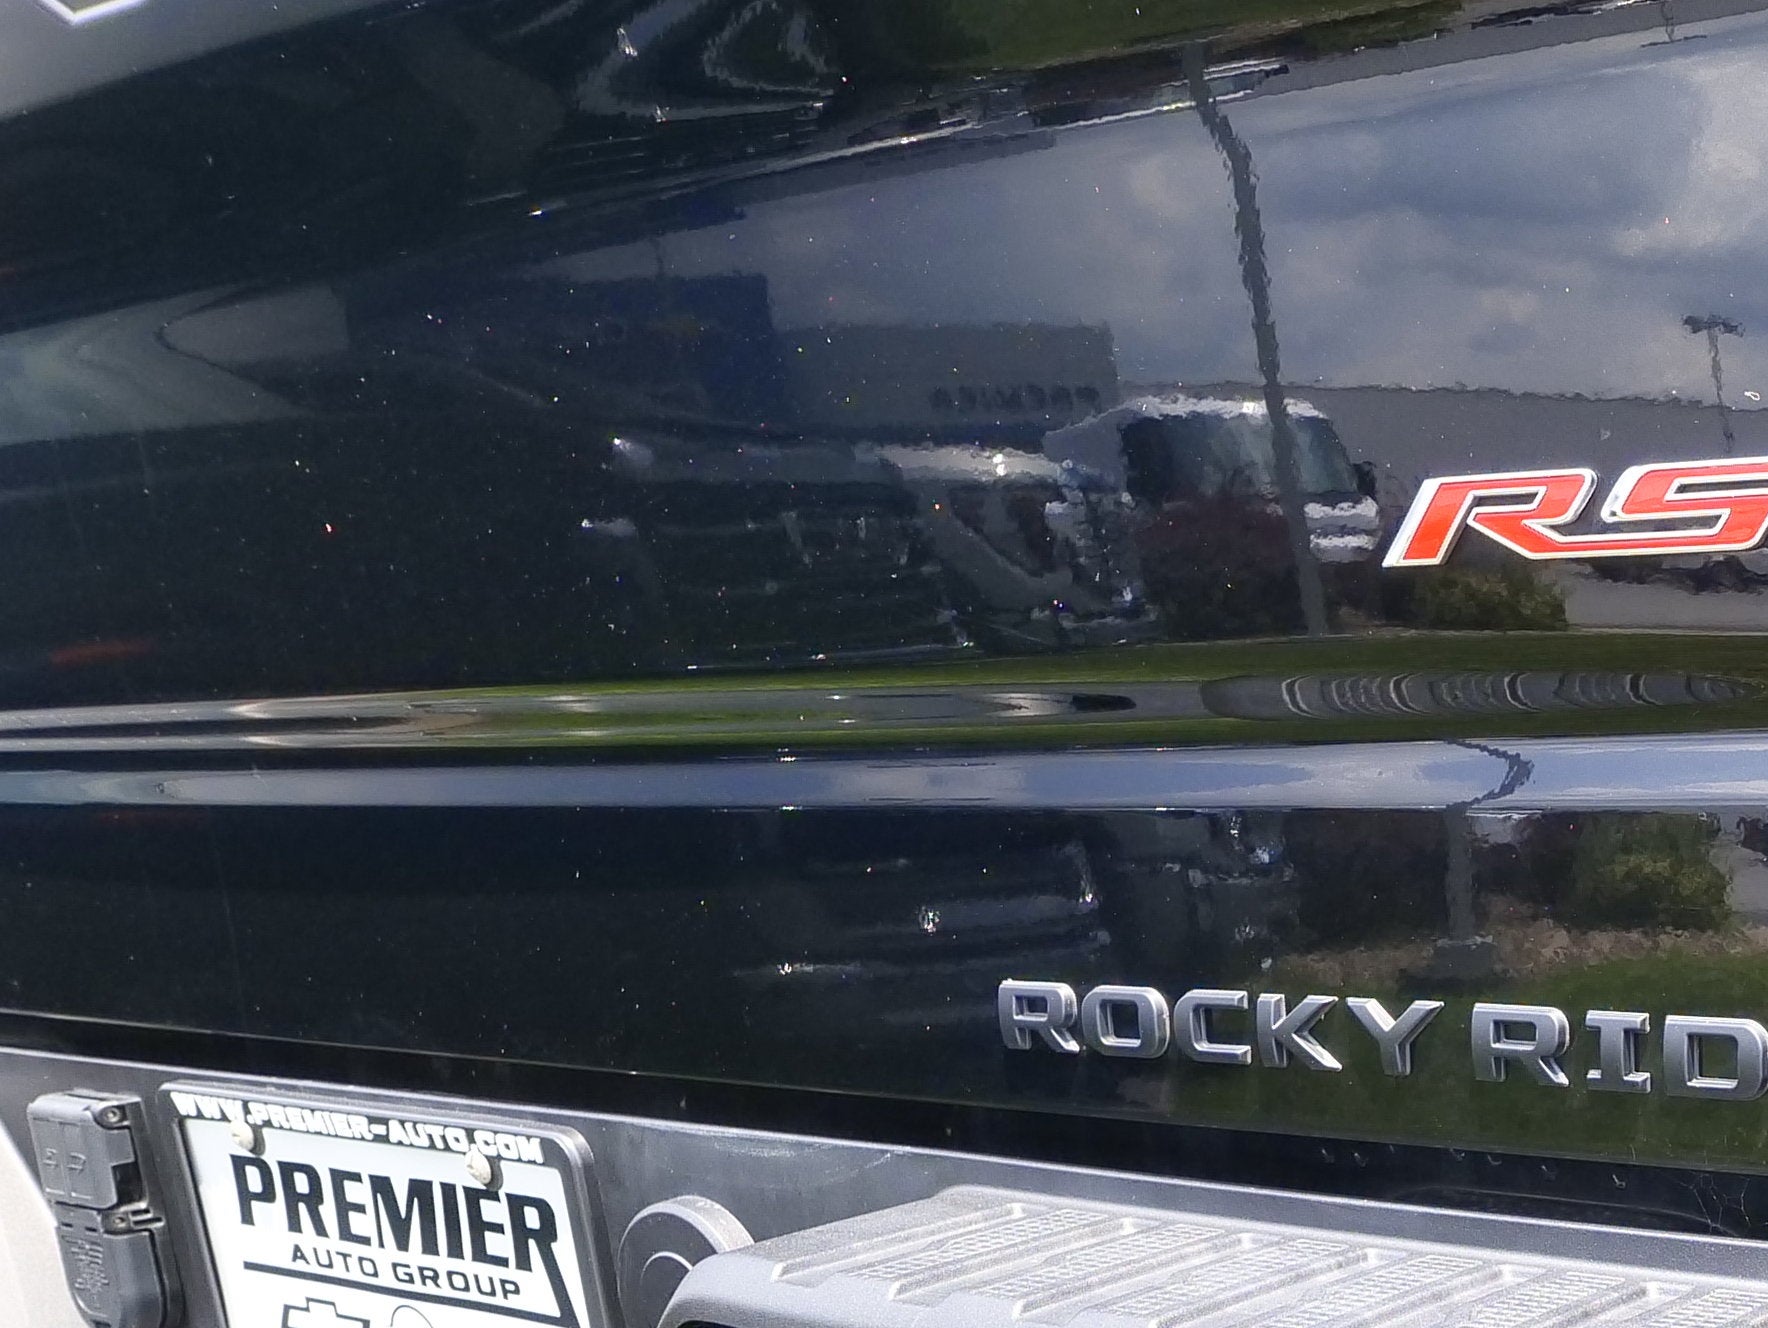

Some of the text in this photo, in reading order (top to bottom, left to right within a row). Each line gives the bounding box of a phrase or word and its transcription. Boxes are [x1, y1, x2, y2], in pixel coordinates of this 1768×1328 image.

[998, 978, 1444, 1076] ROCKY
[170, 1091, 545, 1165] WWW.PREMIER-AUTO.COM
[230, 1153, 562, 1276] PREMIER
[291, 1243, 521, 1301] AUTO GROUP
